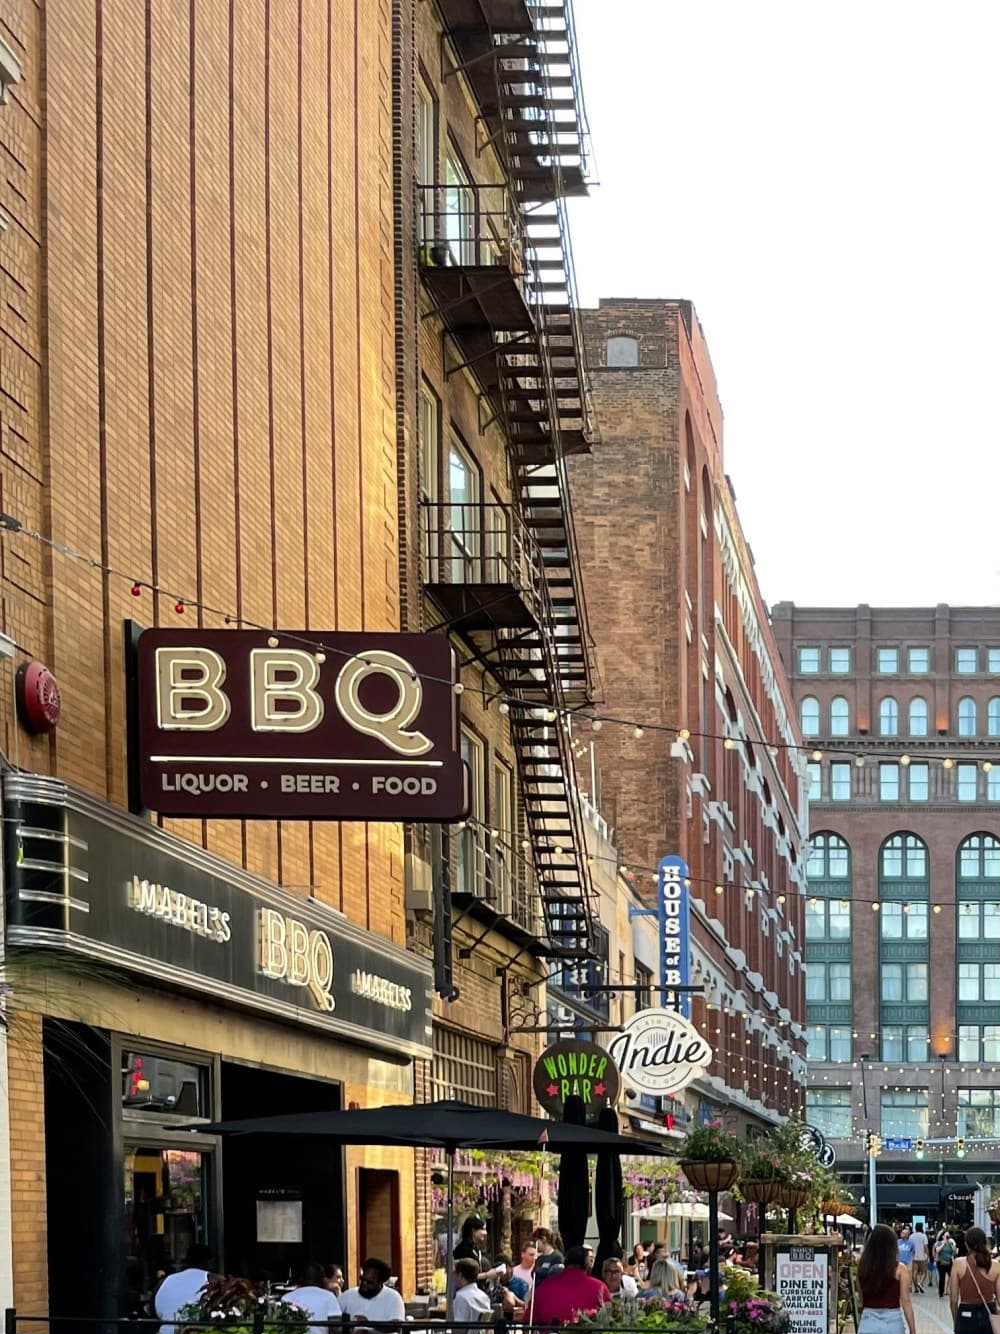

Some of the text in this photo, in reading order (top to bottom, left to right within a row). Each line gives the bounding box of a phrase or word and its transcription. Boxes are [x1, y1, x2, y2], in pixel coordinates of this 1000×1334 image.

[155, 647, 435, 756] BBQ
[161, 773, 437, 795] LIQUOR BEER FOOD
[663, 866, 682, 953] HOUSE
[128, 876, 232, 942] MABEL'S
[258, 907, 336, 1012] BBQ
[666, 956, 679, 966] of
[608, 1030, 707, 1073] Indie
[543, 1052, 608, 1080] WONDER
[561, 1079, 592, 1104] BAR
[780, 1264, 824, 1278] OPEN
[780, 1280, 824, 1289] DINE IN
